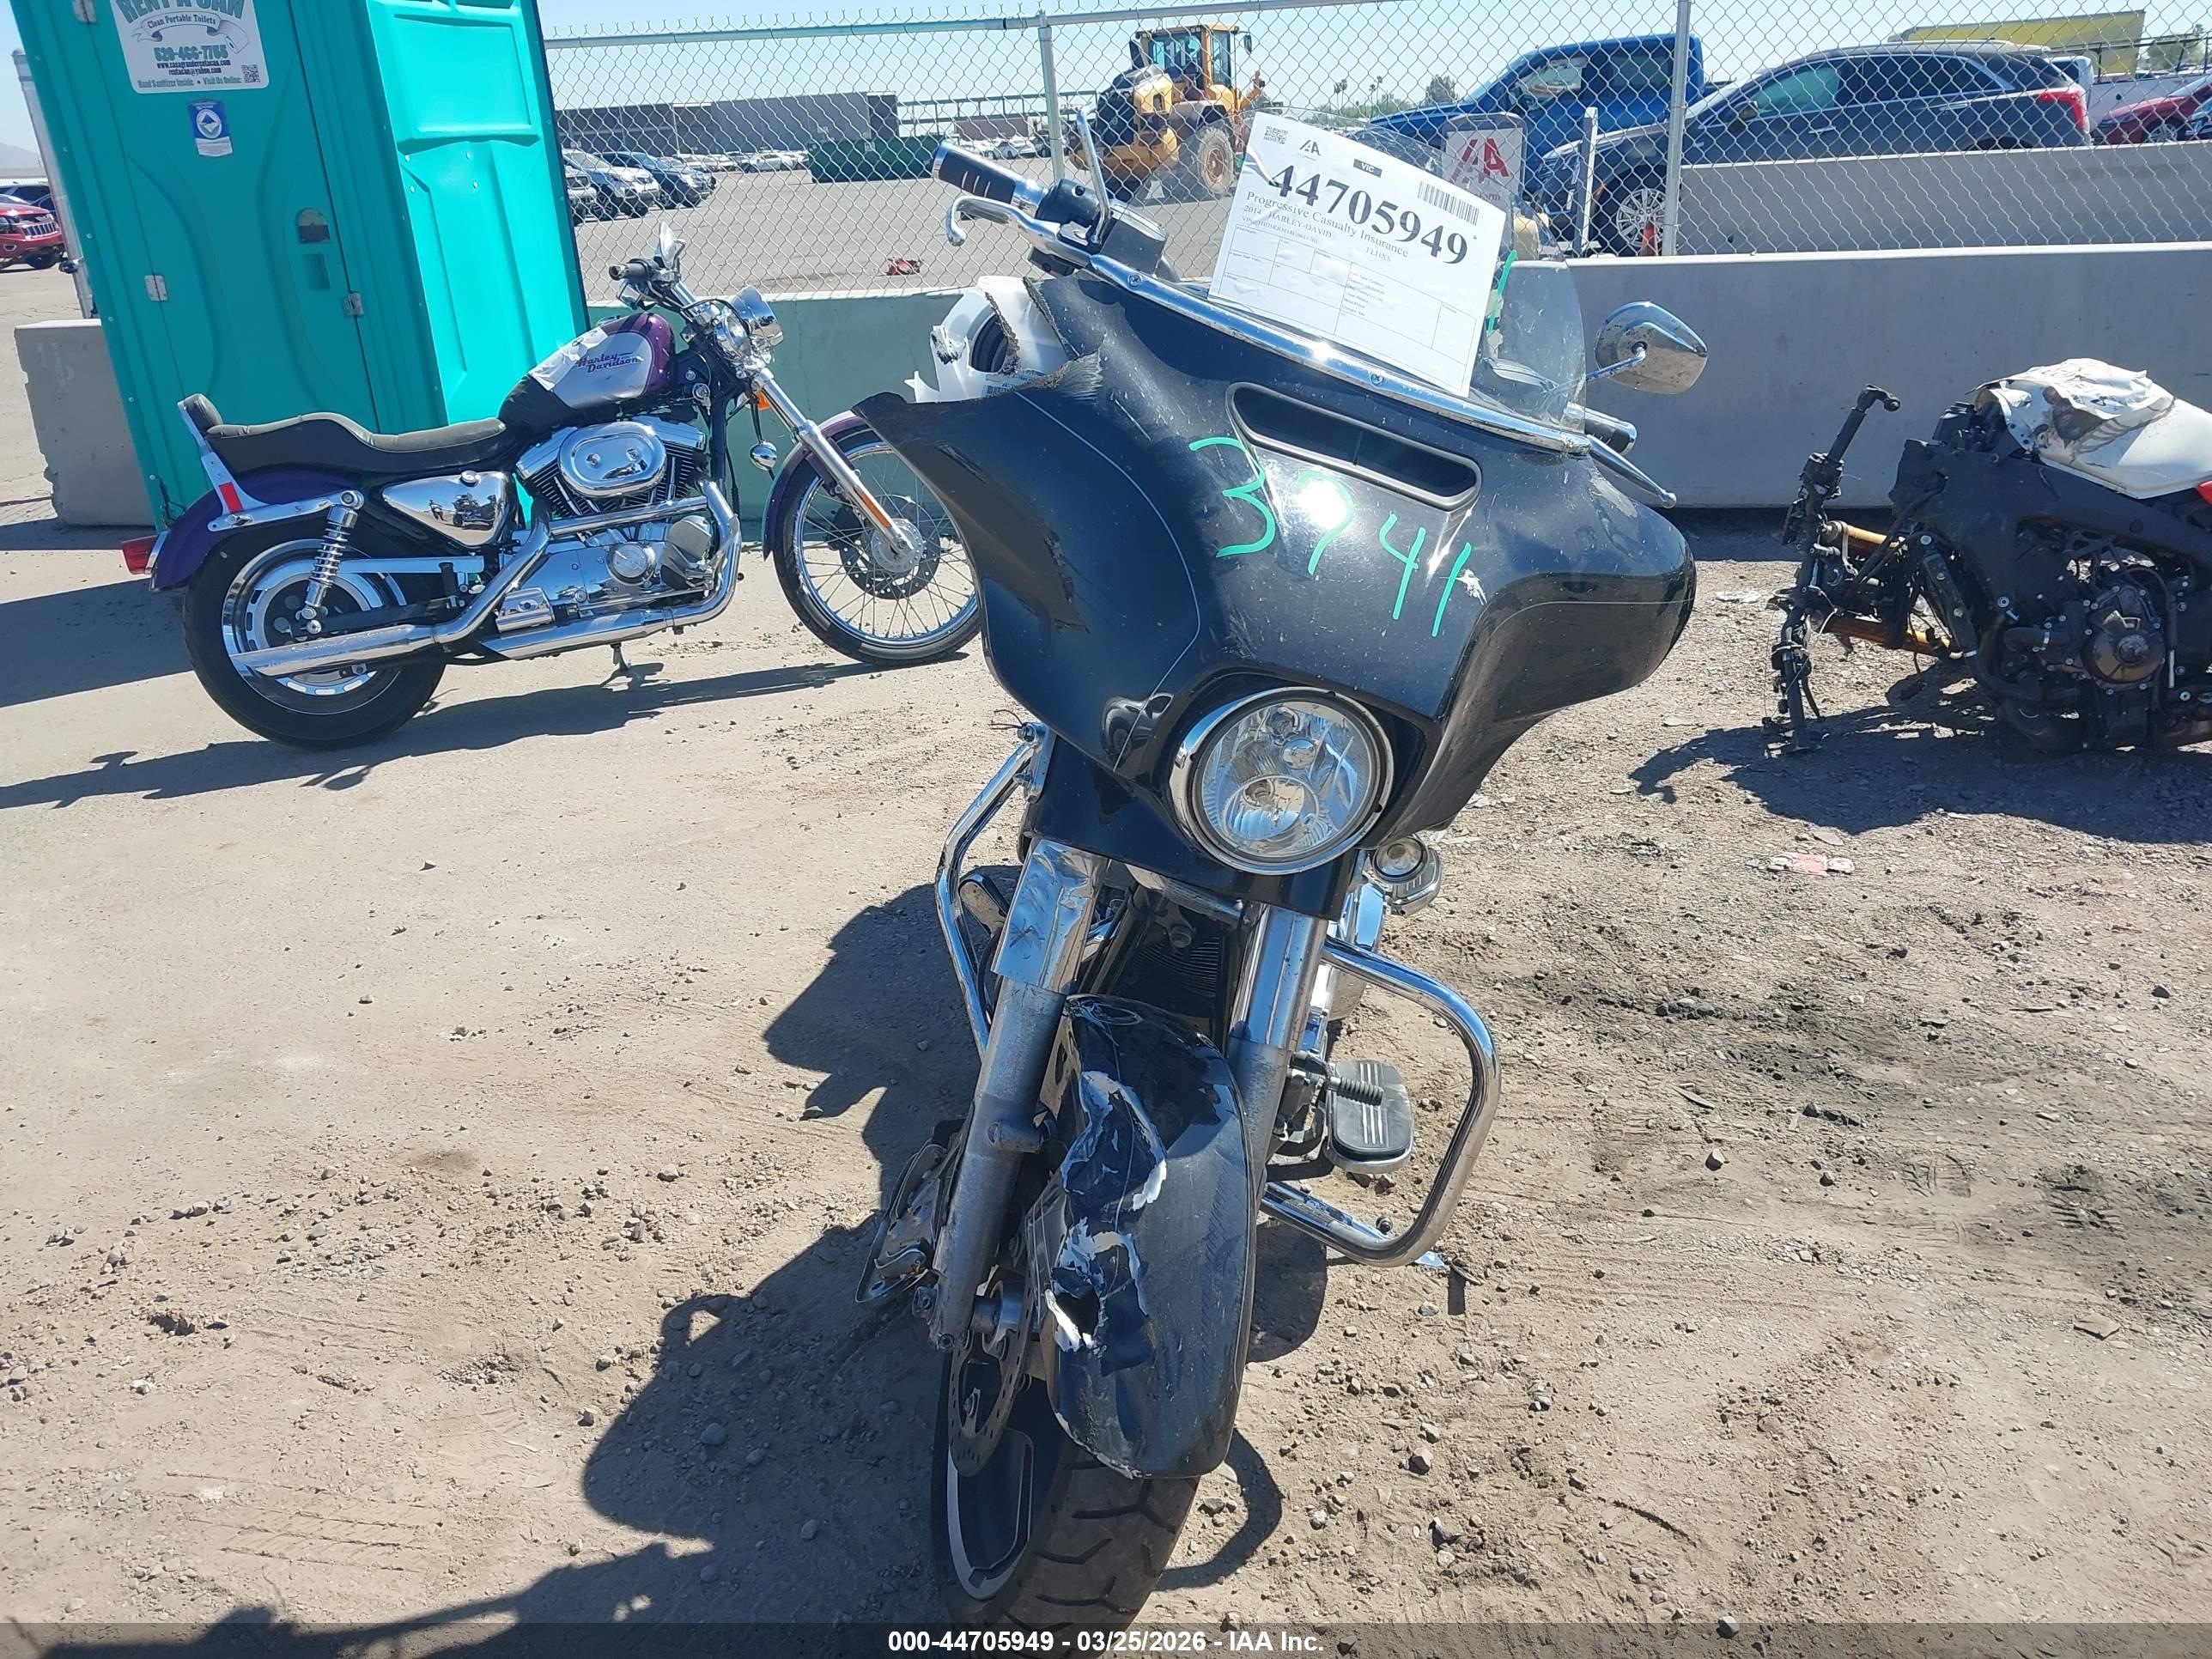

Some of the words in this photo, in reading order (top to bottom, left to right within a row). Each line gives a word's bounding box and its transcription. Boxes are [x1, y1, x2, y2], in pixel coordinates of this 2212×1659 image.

[147, 19, 165, 28] Clean
[164, 14, 192, 24] Portable
[192, 14, 216, 25] Toilets
[1360, 161, 1375, 173] VIC
[1243, 205, 1262, 216] 2014
[1268, 212, 1333, 240] HARLEY-DAVID
[1268, 165, 1468, 264] 44705949
[1247, 191, 1310, 219] Progressive
[1312, 210, 1358, 238] Casualty
[1359, 229, 1409, 258] Insurance
[577, 352, 619, 368] Harley
[586, 356, 640, 374] Davidson
